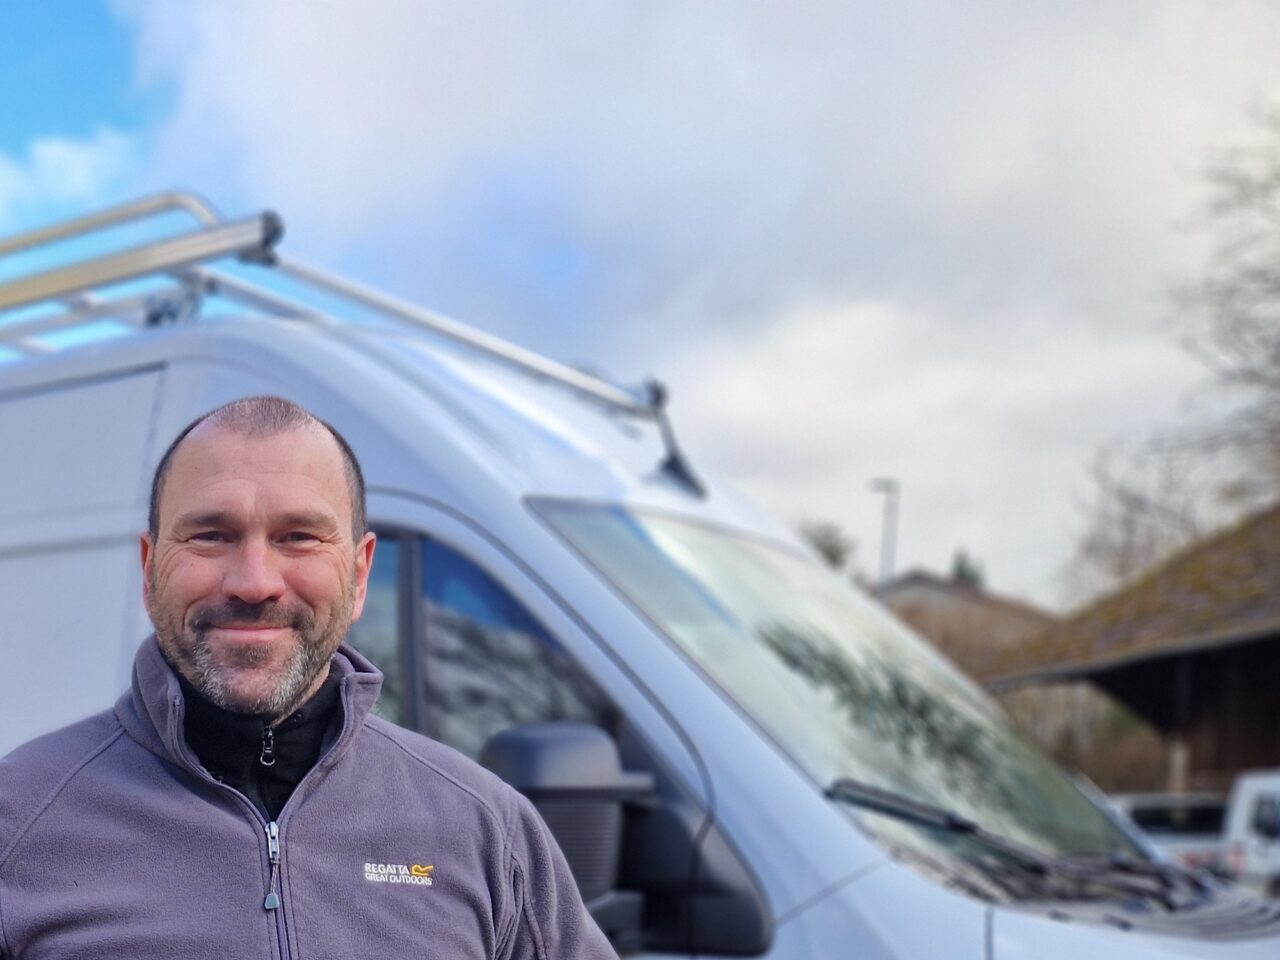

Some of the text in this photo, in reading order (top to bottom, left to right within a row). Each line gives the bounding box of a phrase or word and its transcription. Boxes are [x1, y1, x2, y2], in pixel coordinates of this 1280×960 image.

[364, 863, 410, 874] REGATTA
[365, 873, 433, 886] GREAT OUTDOORS
